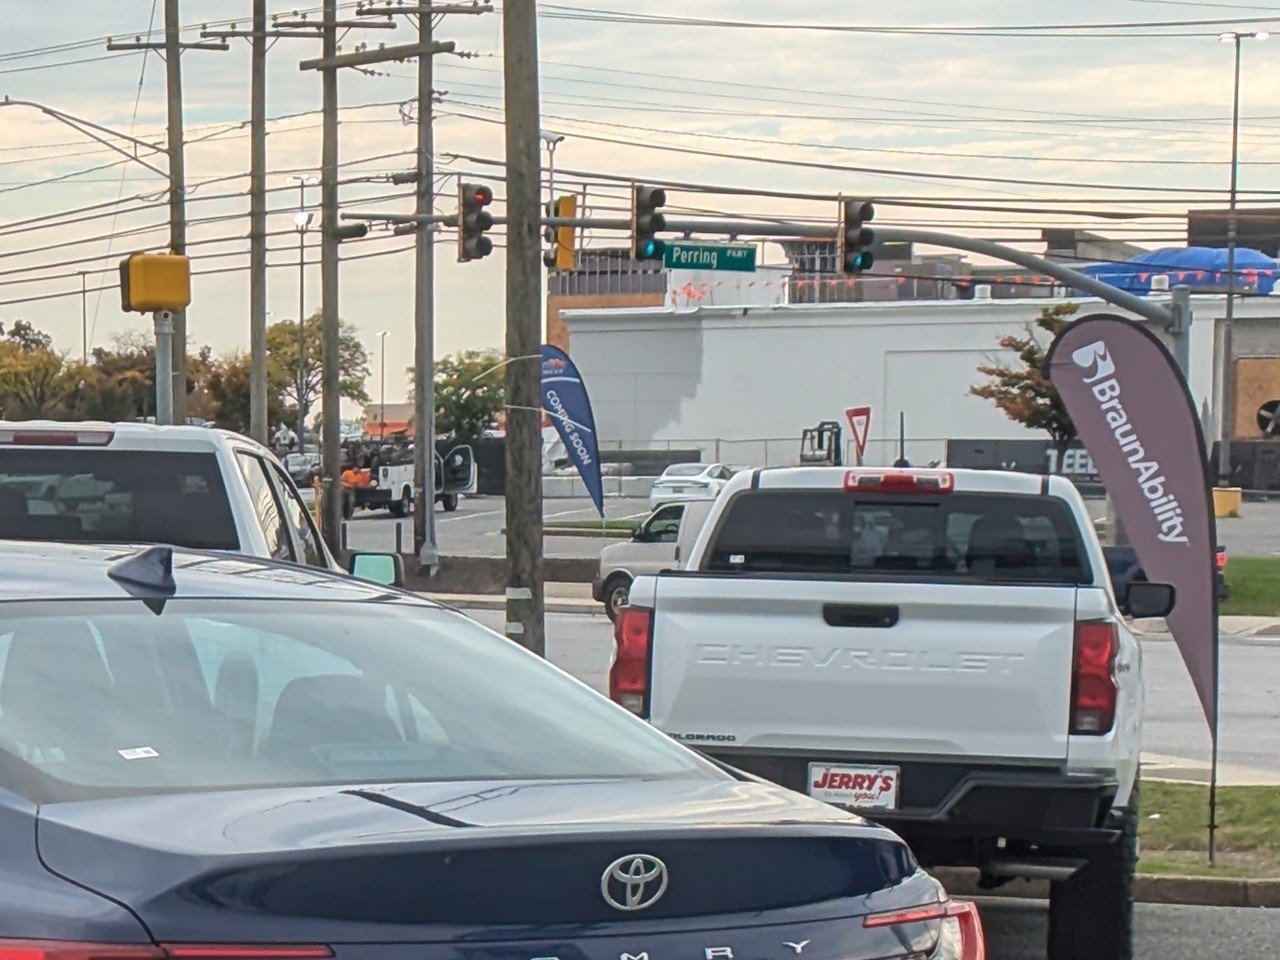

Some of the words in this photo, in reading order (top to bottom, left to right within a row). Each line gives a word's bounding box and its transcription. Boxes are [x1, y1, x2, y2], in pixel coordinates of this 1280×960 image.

[672, 246, 718, 269] Perring
[546, 389, 575, 433] COMING
[569, 431, 592, 466] SOON
[1091, 378, 1190, 545] BraunAbility
[696, 643, 1024, 674] CHEVROLET
[813, 772, 894, 792] JERRY'S
